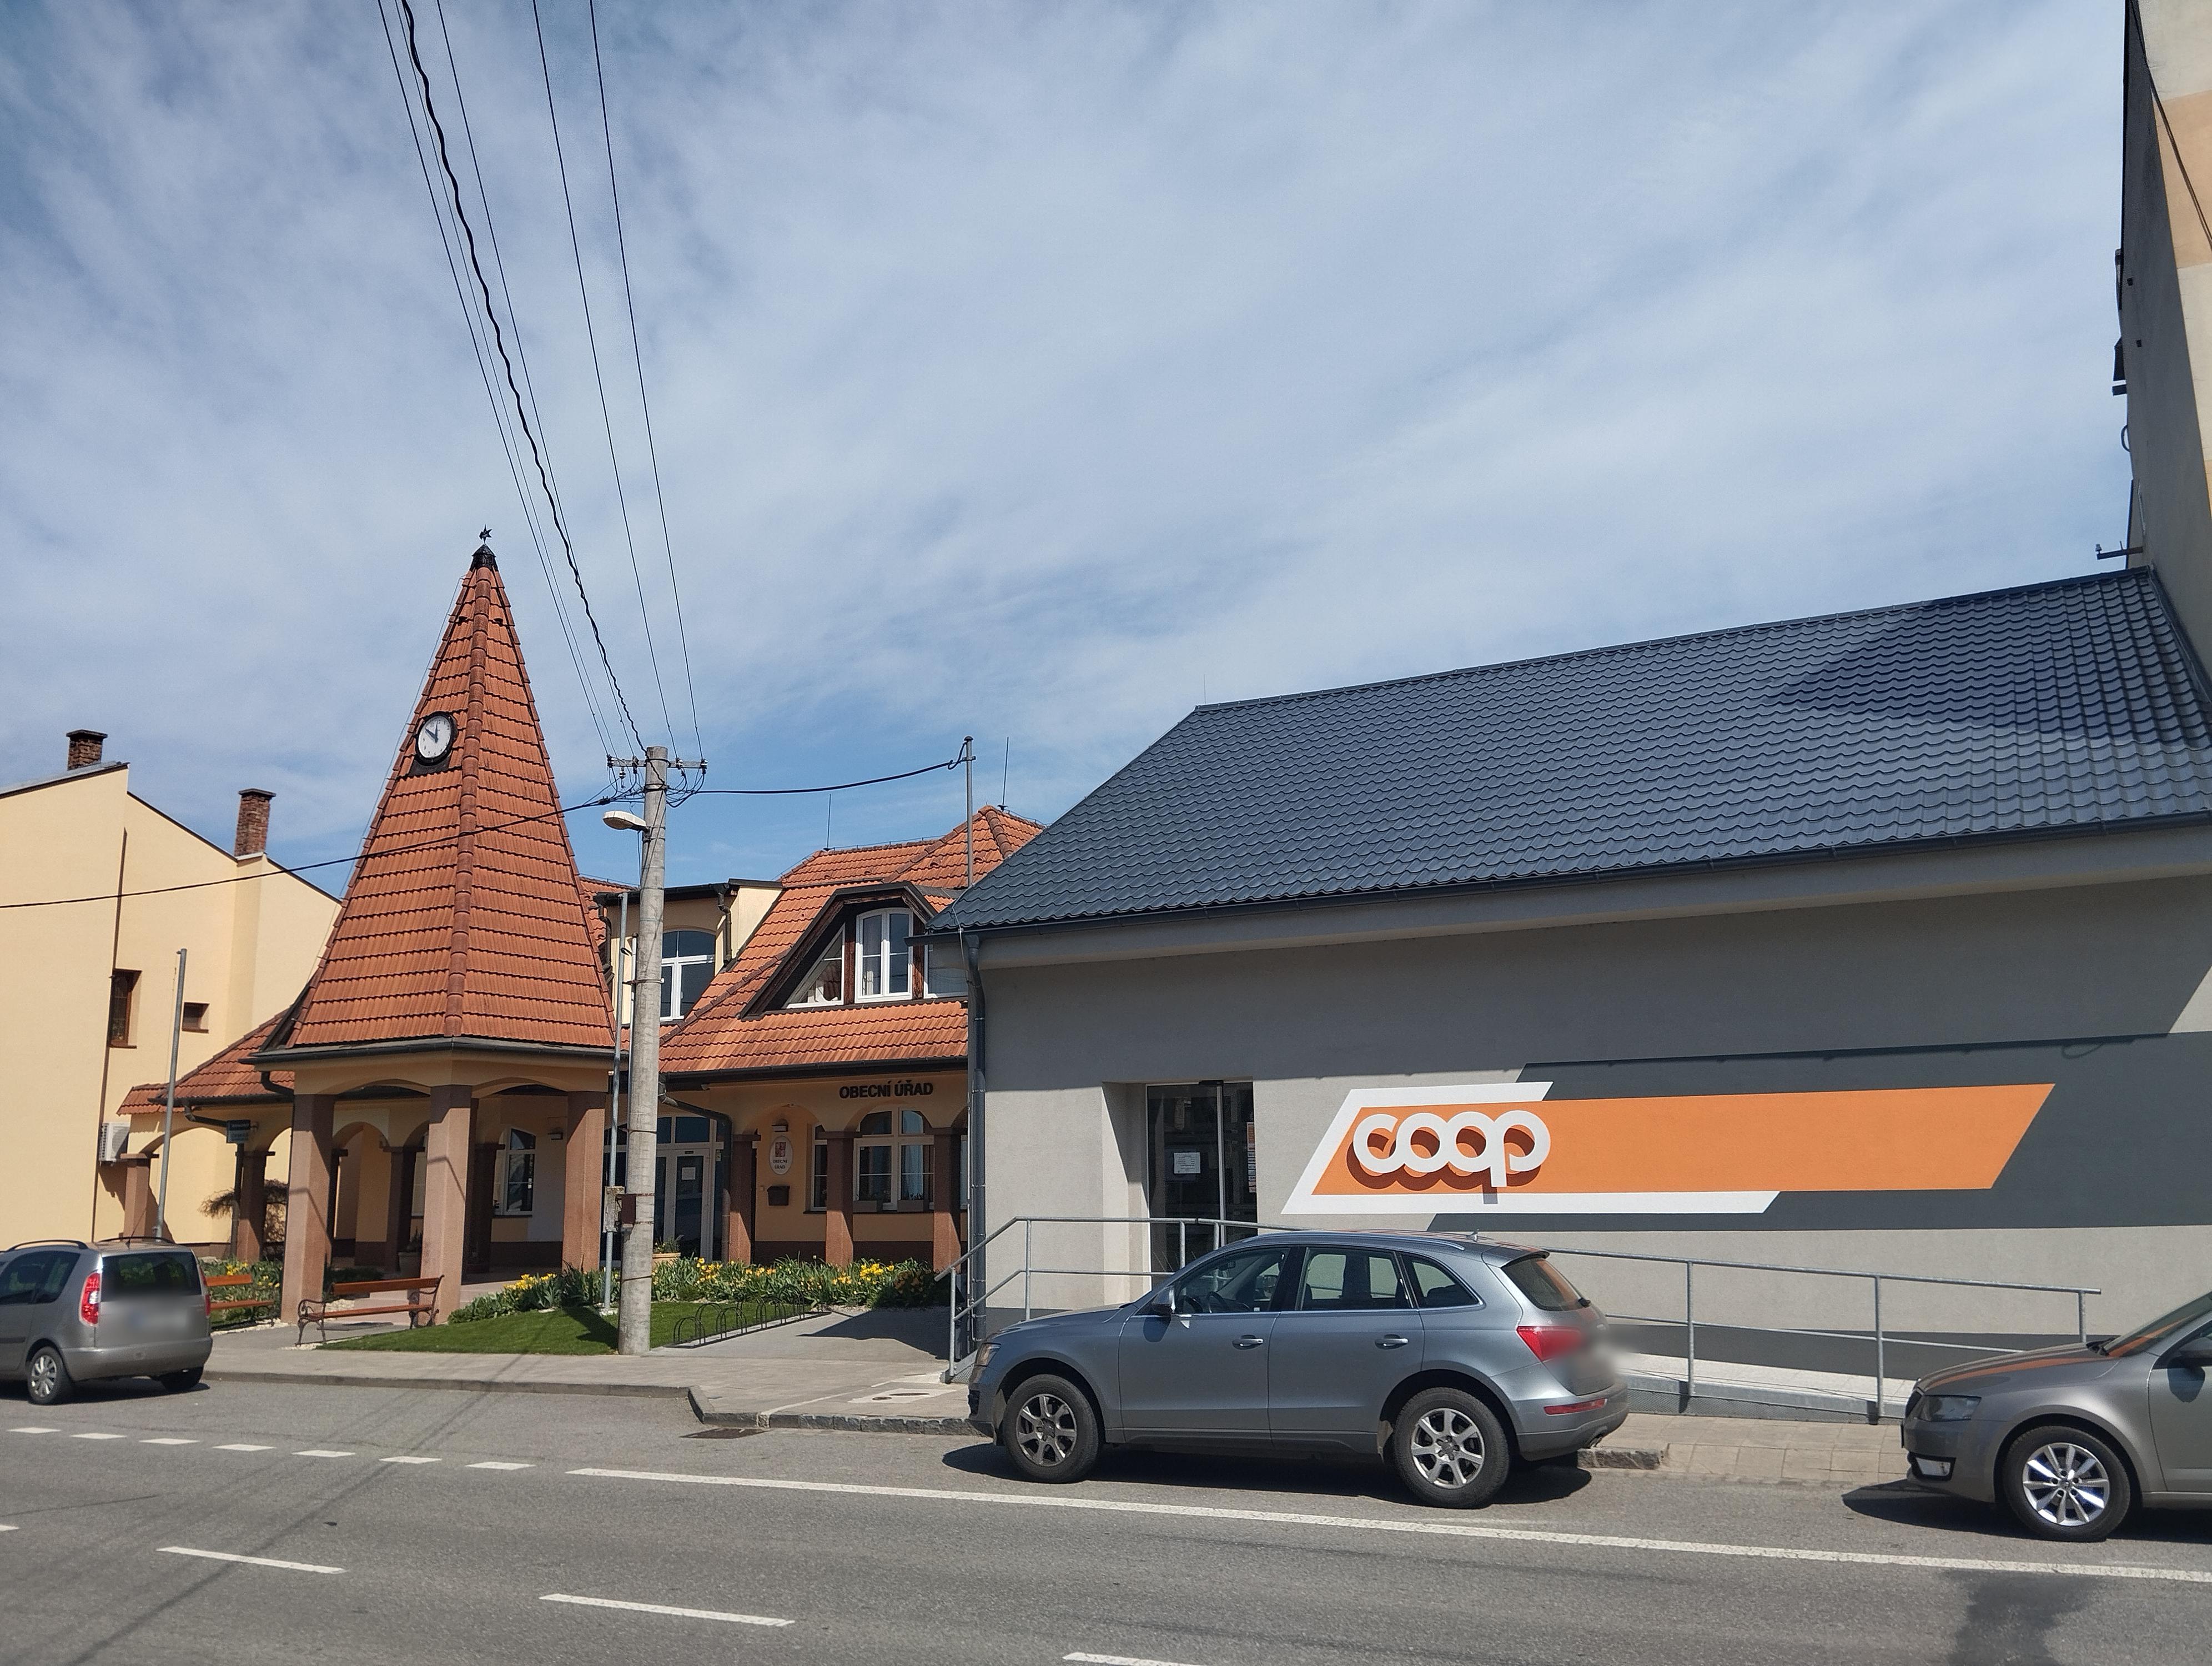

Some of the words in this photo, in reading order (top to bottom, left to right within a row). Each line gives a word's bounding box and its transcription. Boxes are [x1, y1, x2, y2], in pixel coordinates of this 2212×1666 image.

[839, 1080, 891, 1099] OBECNÍ
[894, 1080, 934, 1097] ÚŘAD
[1353, 1110, 1551, 1187] coop
